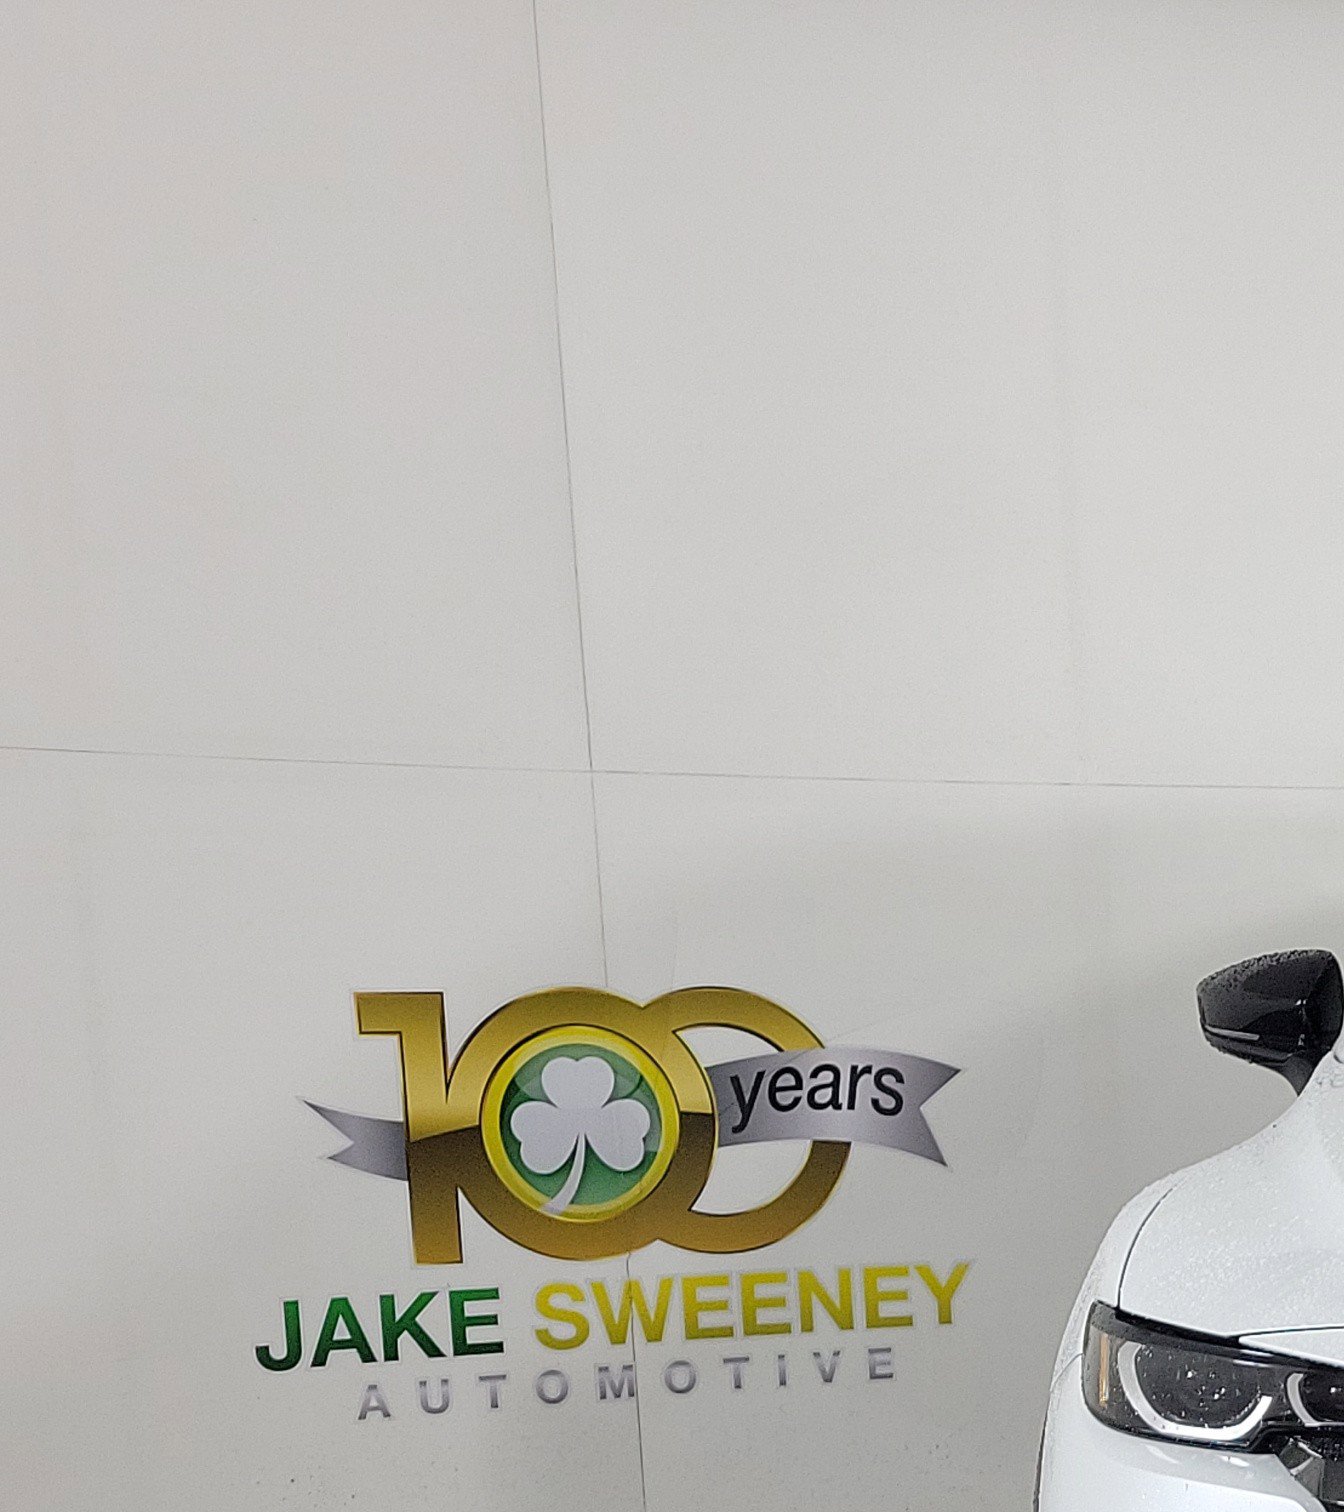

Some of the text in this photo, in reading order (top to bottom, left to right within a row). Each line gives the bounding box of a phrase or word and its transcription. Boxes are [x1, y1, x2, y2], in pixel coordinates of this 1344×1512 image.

[354, 986, 906, 1264] 100 years
[255, 1263, 971, 1371] JAKE SWEENEY
[357, 1347, 896, 1421] AUTOMOTIVE
